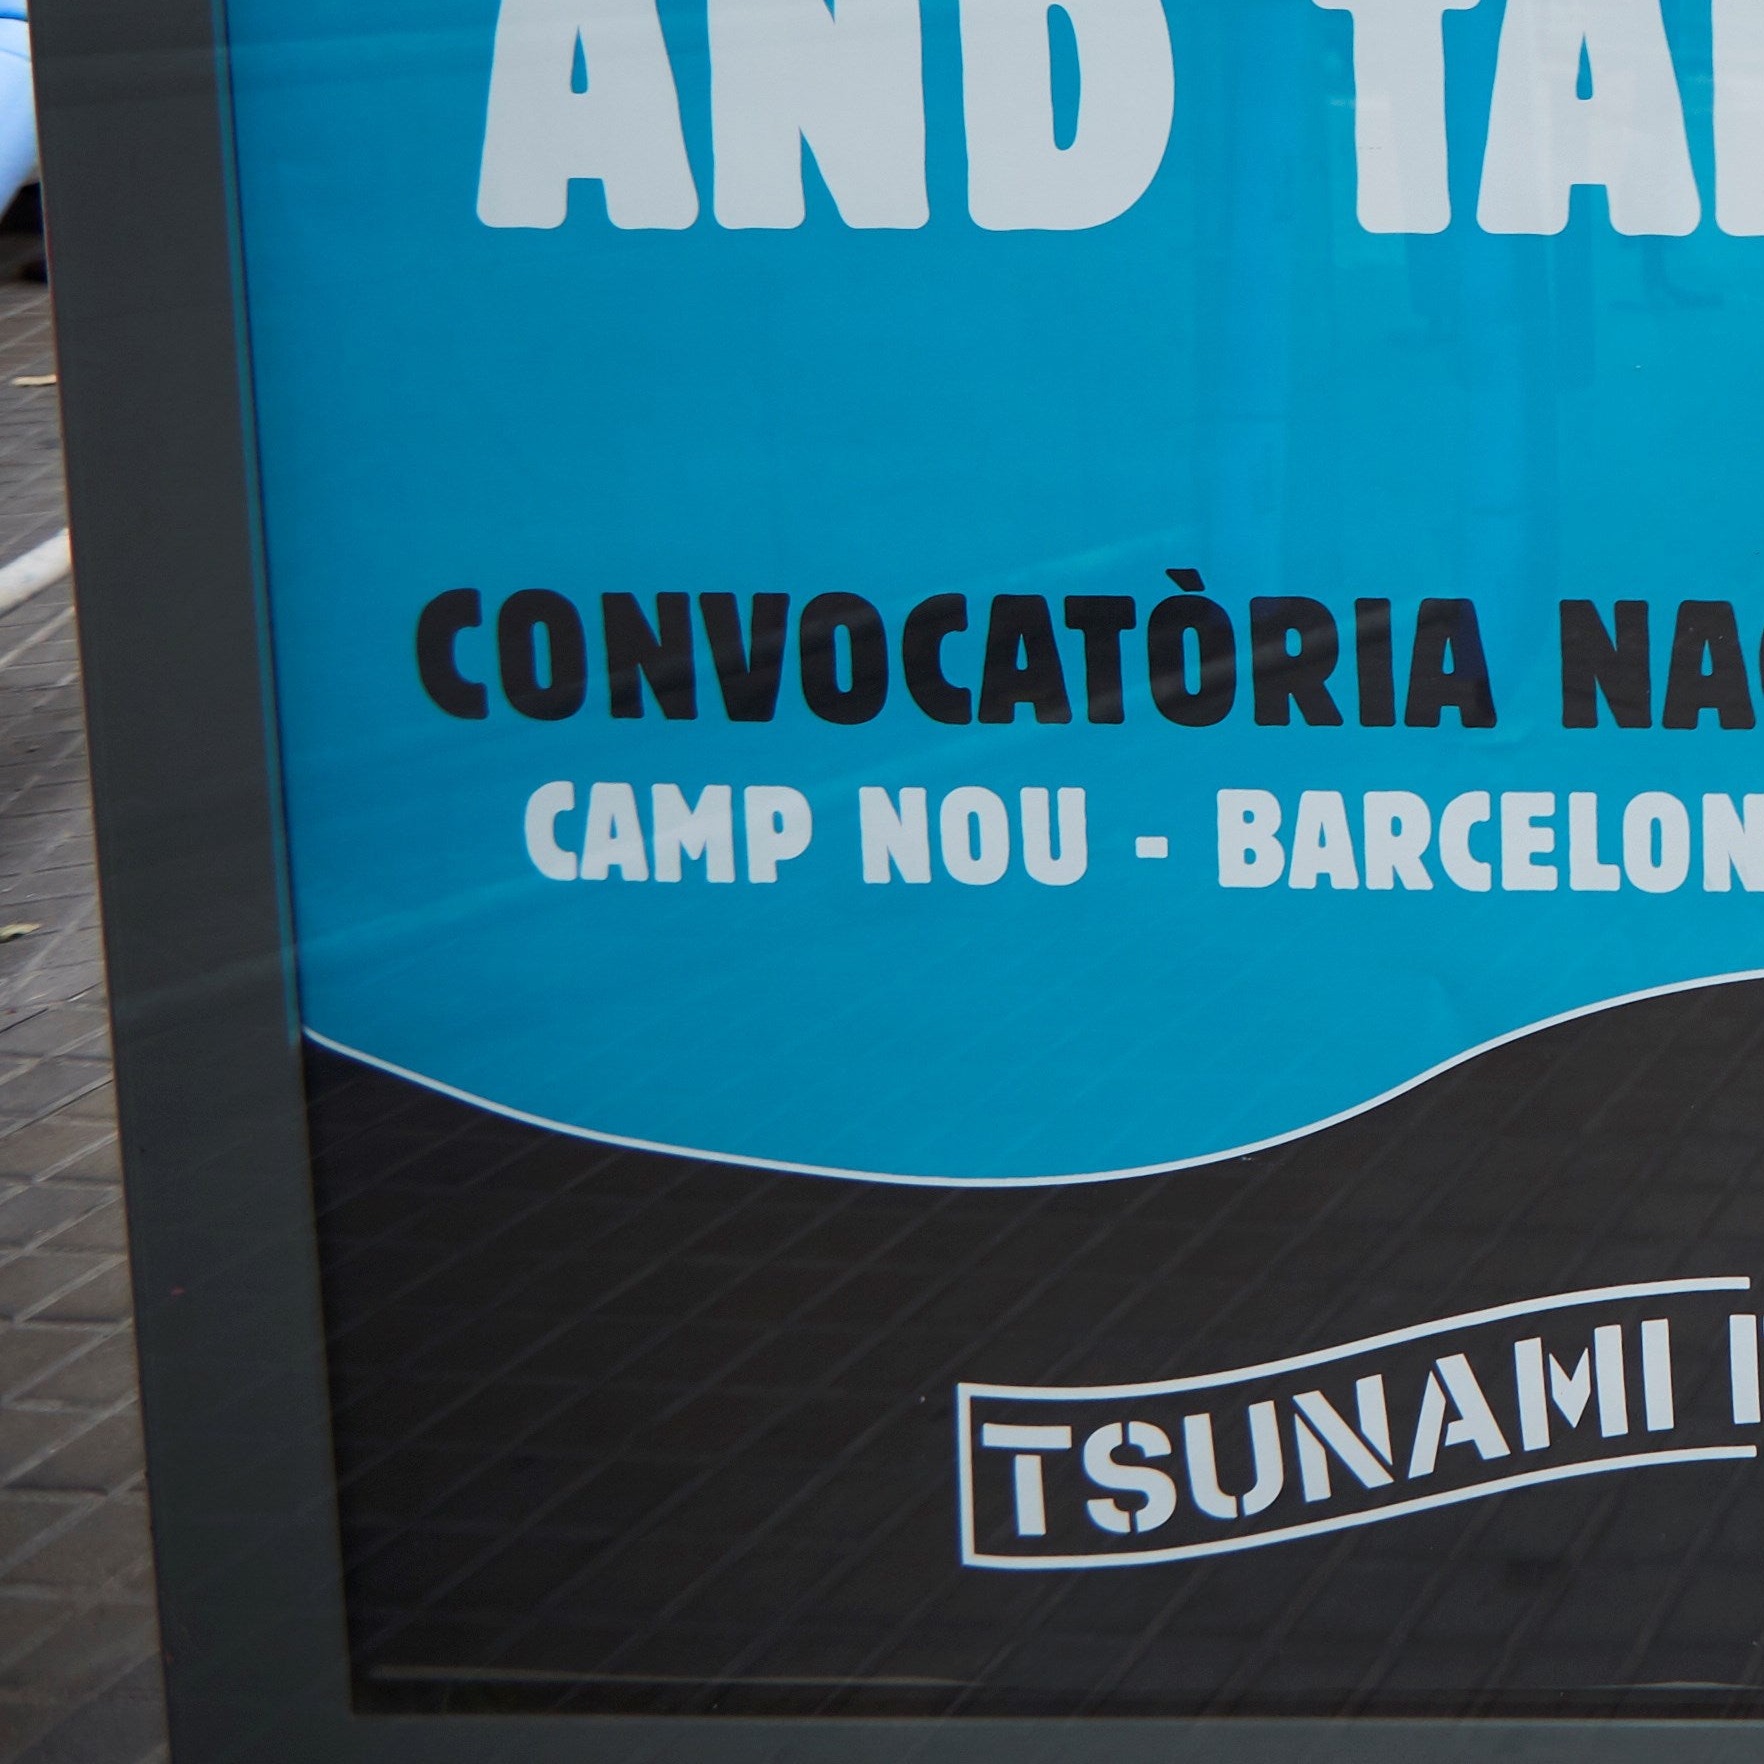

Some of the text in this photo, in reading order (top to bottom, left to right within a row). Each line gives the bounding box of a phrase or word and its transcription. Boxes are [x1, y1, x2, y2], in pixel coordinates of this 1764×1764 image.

[413, 570, 1498, 729] CONVOCATÒRIA
[525, 781, 812, 883] CAMP
[859, 786, 1088, 886] NOU
[983, 1318, 1675, 1535] TSUNAMI
